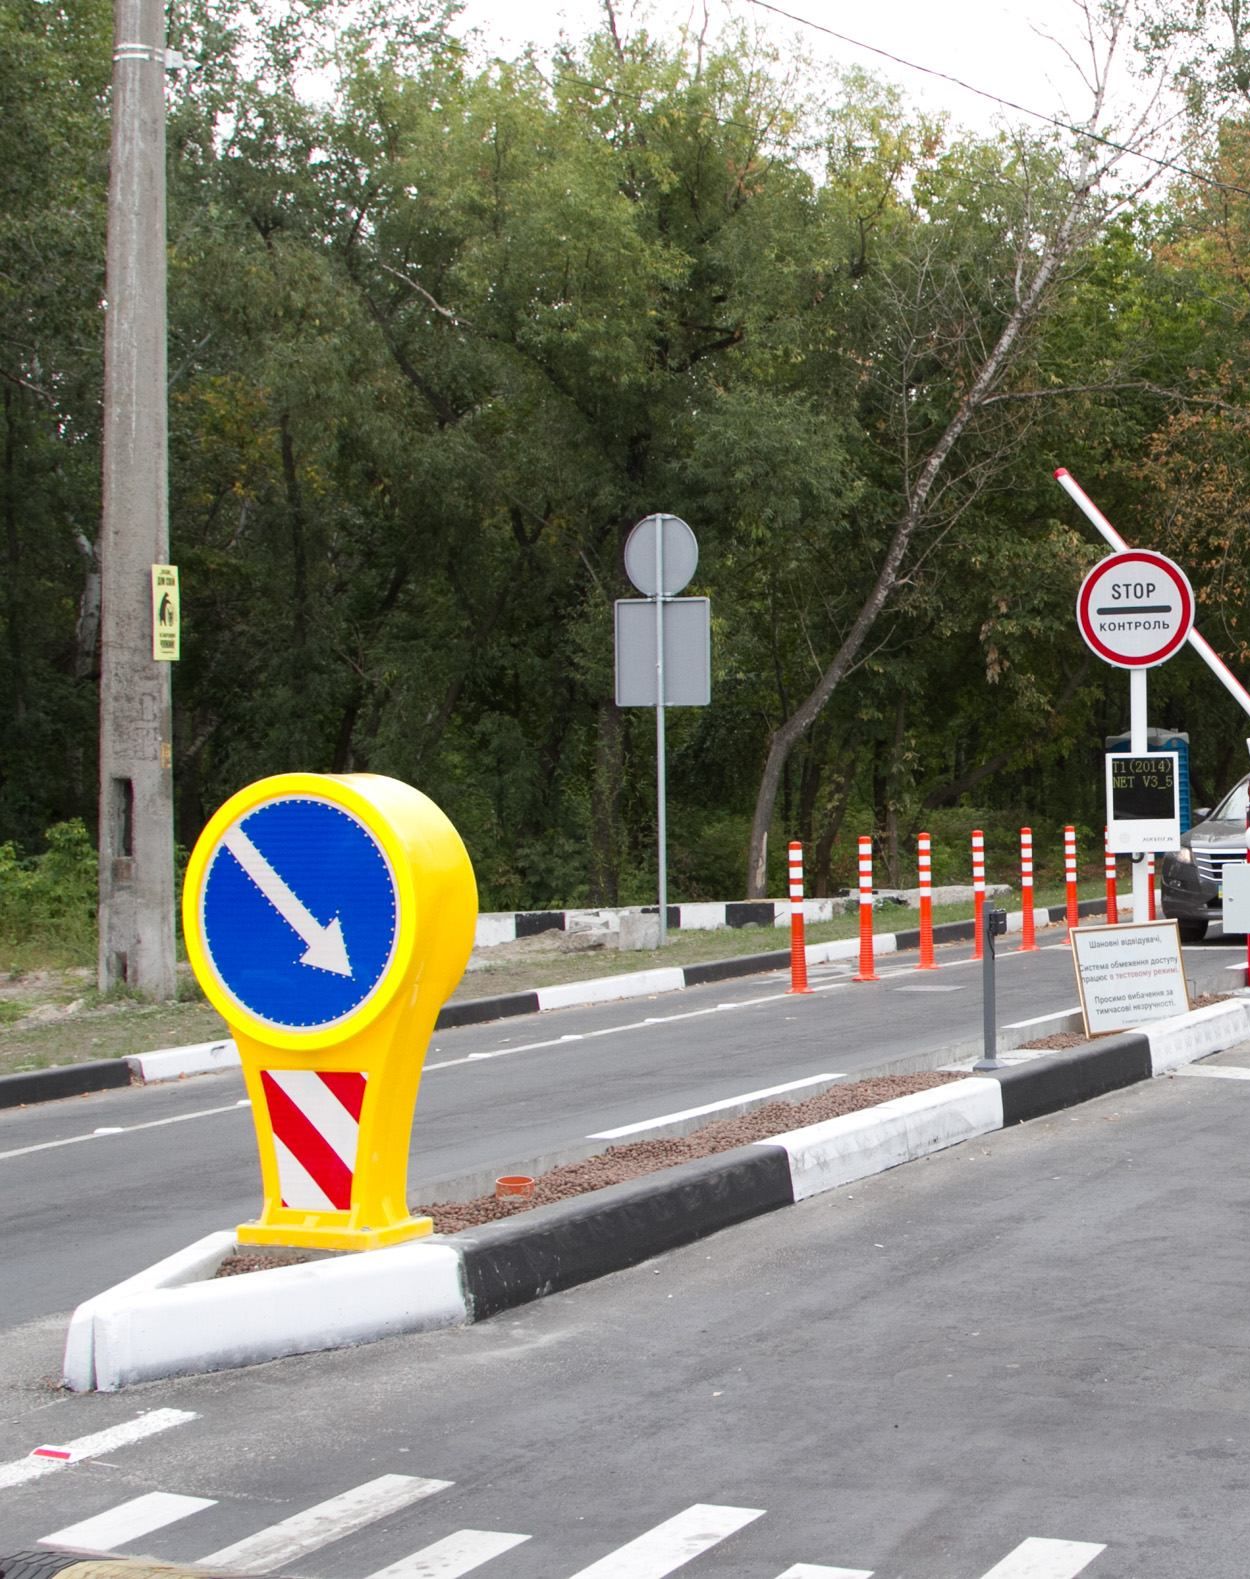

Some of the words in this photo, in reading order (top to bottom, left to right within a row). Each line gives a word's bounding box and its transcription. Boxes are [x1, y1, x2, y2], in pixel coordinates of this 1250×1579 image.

[1111, 582, 1156, 600] STOP
[1100, 620, 1170, 632] КОНТРОЛЬ
[1112, 760, 1171, 773] T1(2014)
[1112, 776, 1135, 788] NET
[1142, 775, 1173, 789] V3_5
